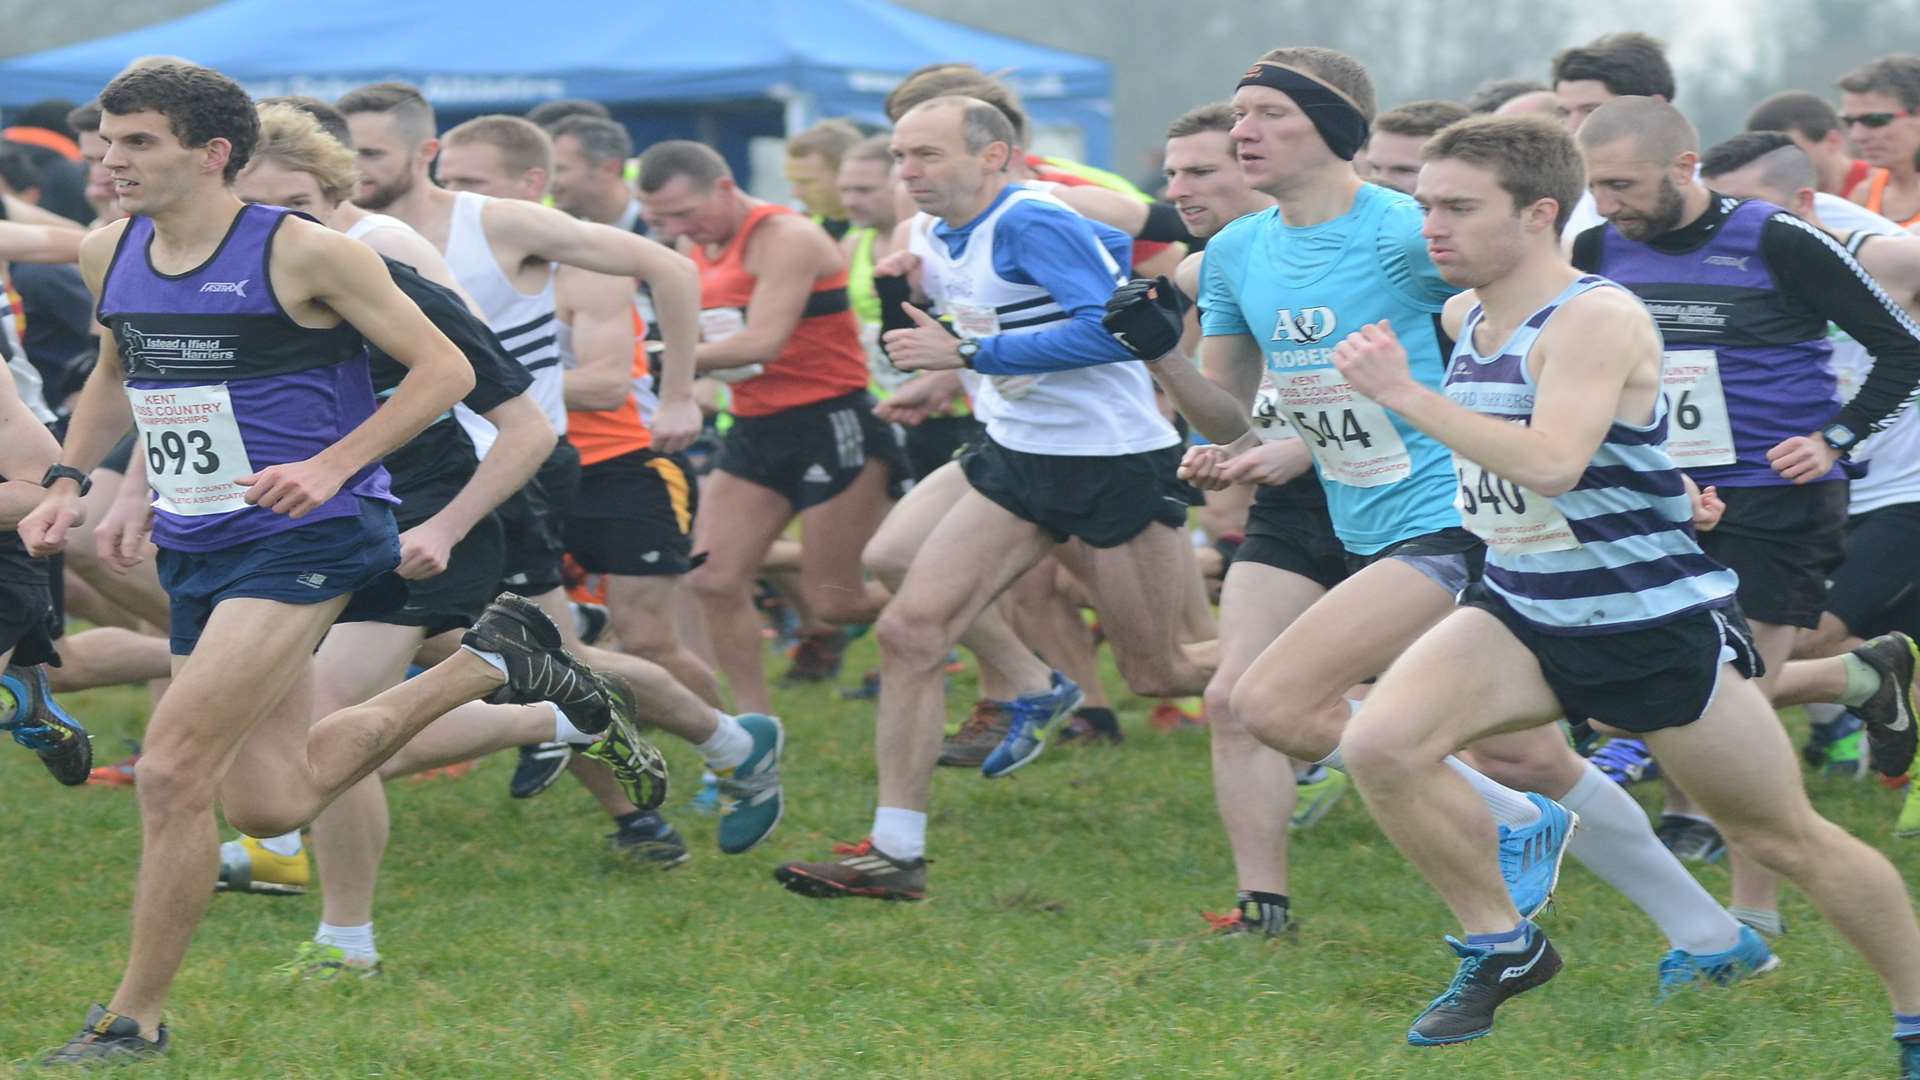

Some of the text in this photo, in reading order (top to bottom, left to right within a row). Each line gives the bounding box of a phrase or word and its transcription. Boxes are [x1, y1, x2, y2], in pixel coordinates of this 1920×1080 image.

[1270, 306, 1337, 346] A&D
[182, 349, 234, 360] Harriers
[1290, 375, 1321, 385] KENT
[144, 394, 176, 405] KENT
[154, 402, 222, 417] COUNTRY
[1294, 407, 1372, 451] 544
[146, 429, 221, 475] 693
[194, 482, 233, 493] COUNTY
